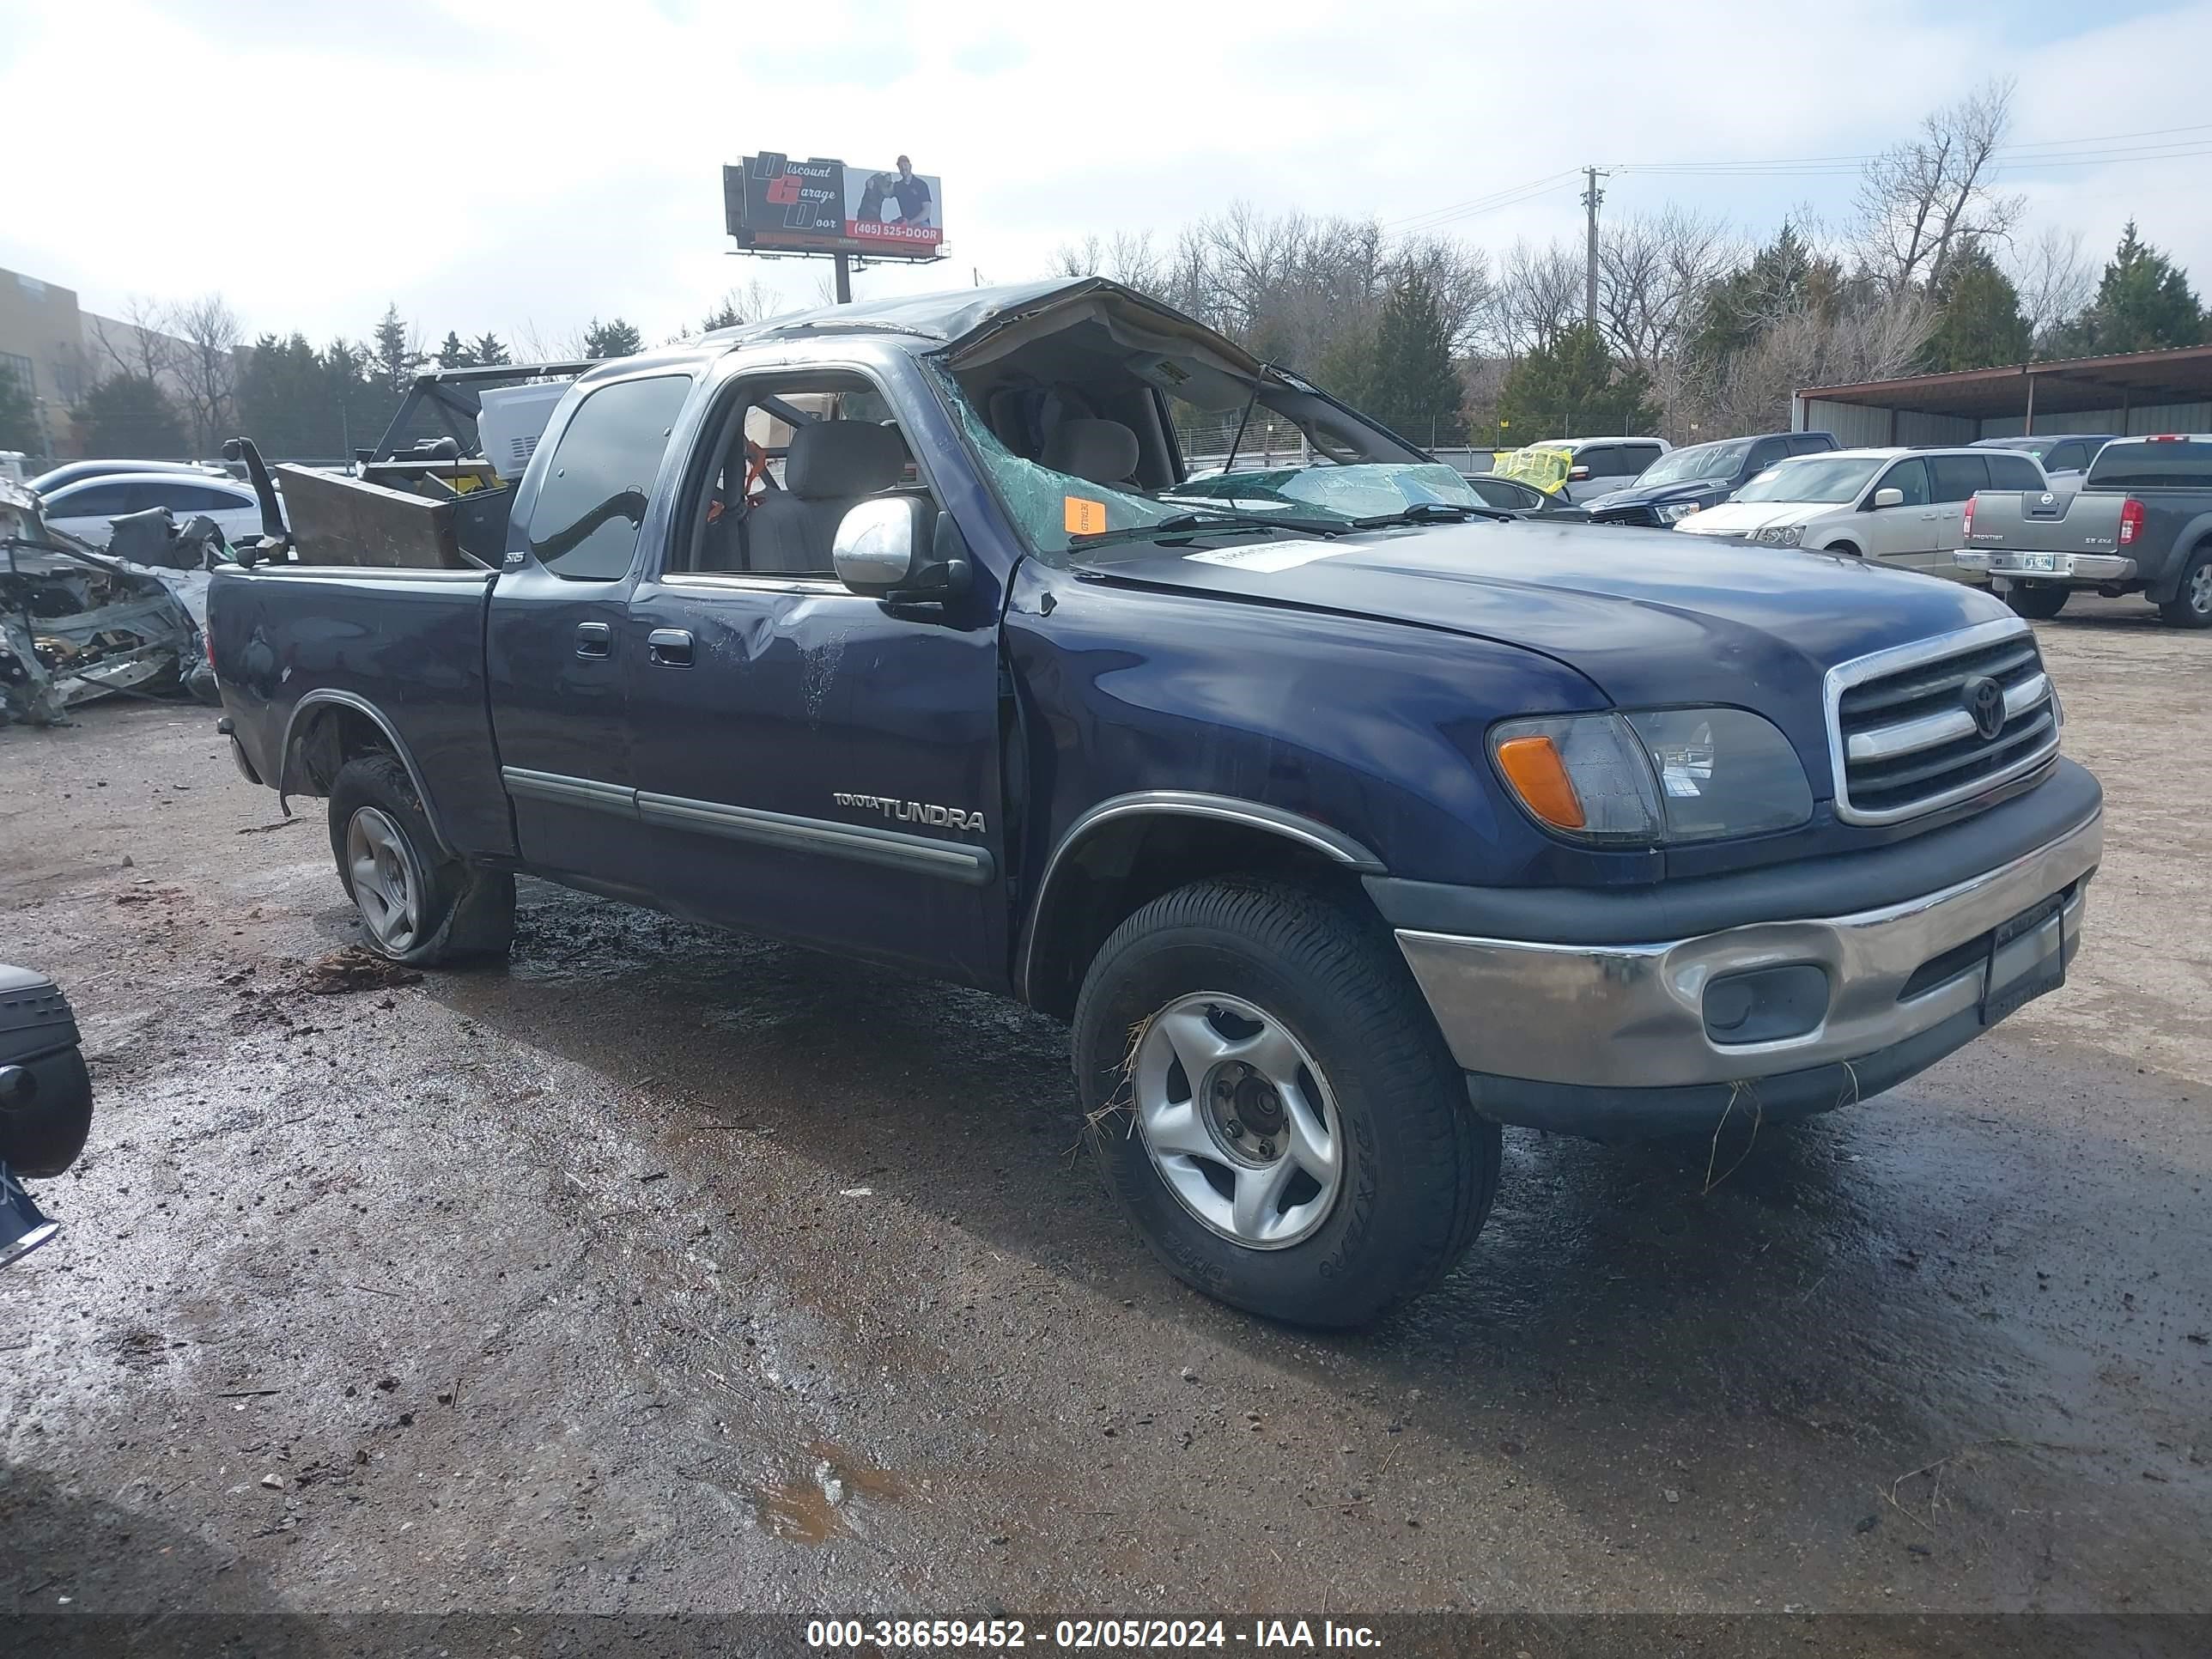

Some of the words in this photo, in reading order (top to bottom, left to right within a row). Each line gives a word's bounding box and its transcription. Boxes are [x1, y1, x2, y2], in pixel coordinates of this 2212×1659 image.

[783, 200, 837, 229] Door
[854, 222, 880, 236] (405)
[883, 225, 938, 240] 525-DOOR
[1080, 502, 1090, 532] DETAILED
[833, 793, 880, 810] TOYOTA
[878, 797, 987, 833] TUNDRA
